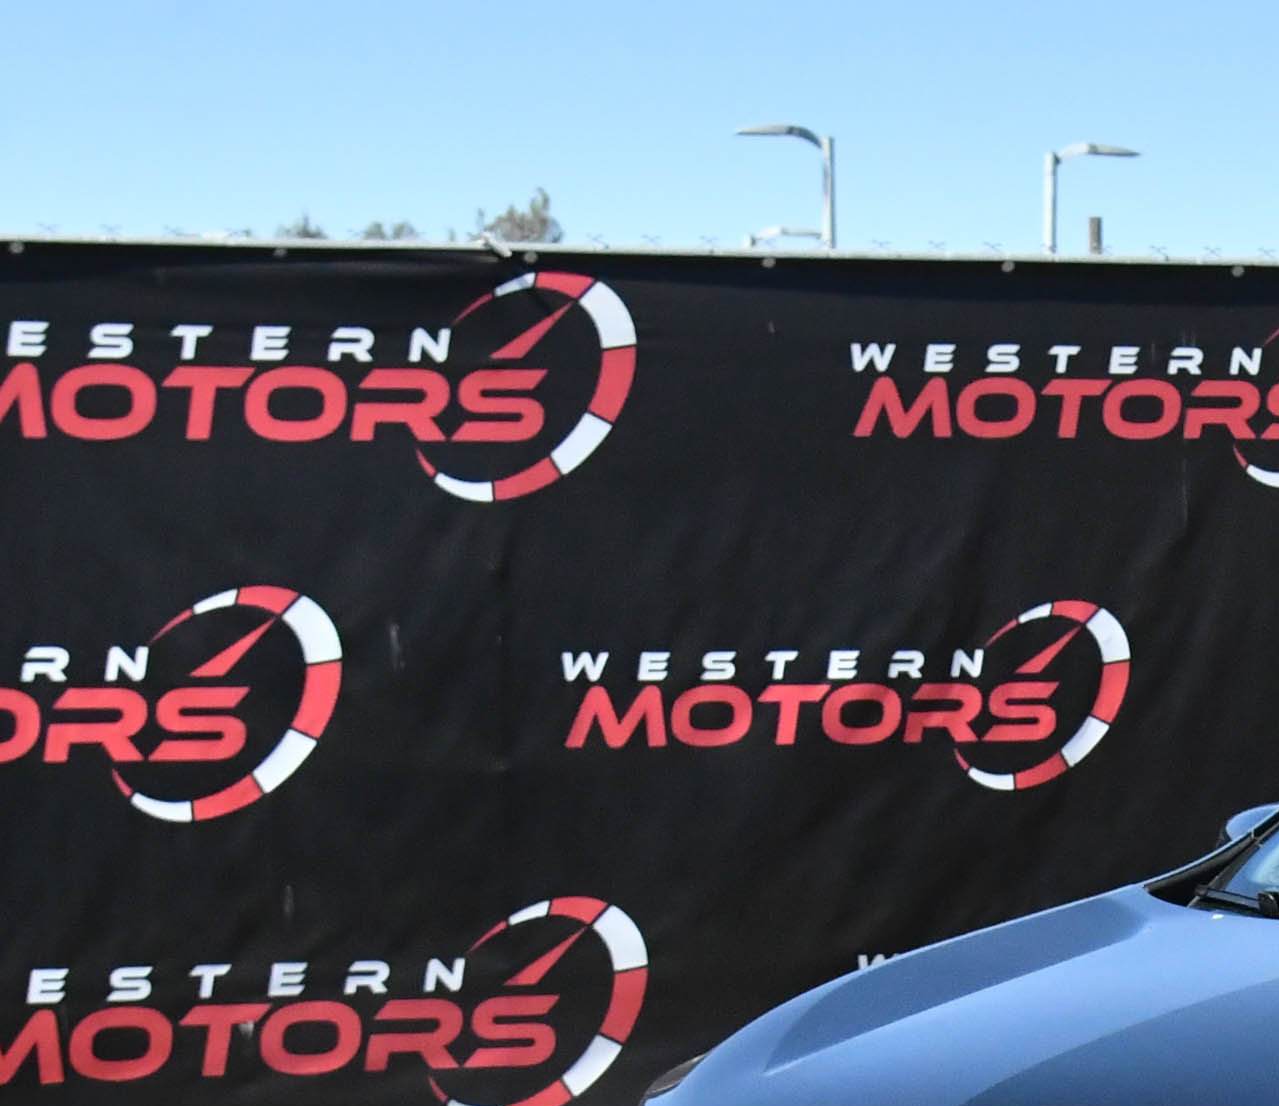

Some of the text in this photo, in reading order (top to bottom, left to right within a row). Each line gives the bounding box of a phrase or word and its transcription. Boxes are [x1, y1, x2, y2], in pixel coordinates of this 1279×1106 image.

[7, 321, 451, 363] ESTERN
[850, 343, 1262, 376] WESTERN
[561, 648, 985, 682] WESTERN
[565, 681, 1059, 749] MOTORS
[26, 958, 466, 1005] ESTERN
